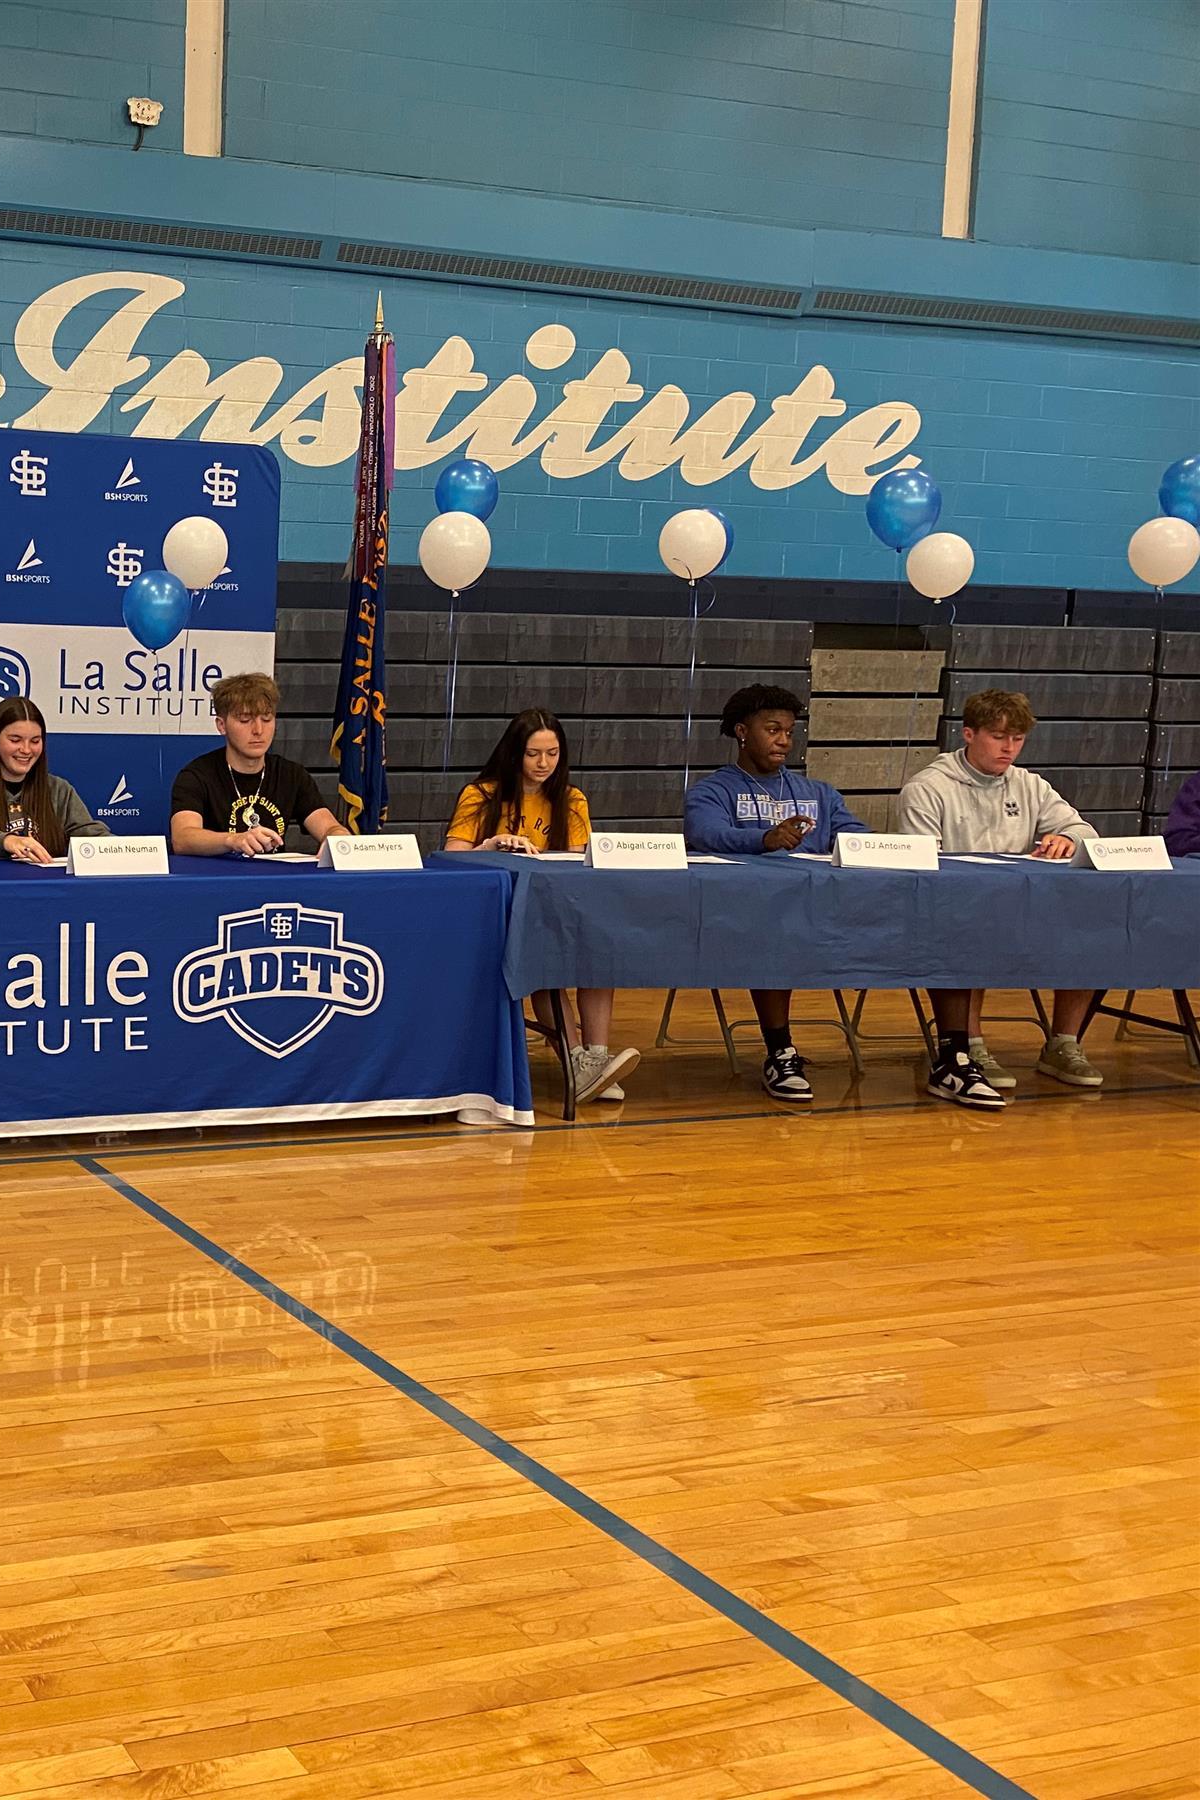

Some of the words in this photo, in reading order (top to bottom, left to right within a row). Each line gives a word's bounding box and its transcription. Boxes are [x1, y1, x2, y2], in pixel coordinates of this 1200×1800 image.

[60, 648, 105, 690] La
[123, 648, 223, 692] Salle
[259, 797, 281, 817] SAINT
[98, 845, 123, 854] Leilah
[125, 845, 158, 853] Neuman
[354, 843, 377, 852] Adam
[377, 843, 404, 852] Myers
[616, 841, 645, 851] Abigail
[647, 841, 678, 850] Carroll
[864, 841, 876, 849] DJ
[878, 842, 912, 850] Antoine
[1106, 846, 1126, 854] Liam
[188, 952, 369, 1006] CADETS
